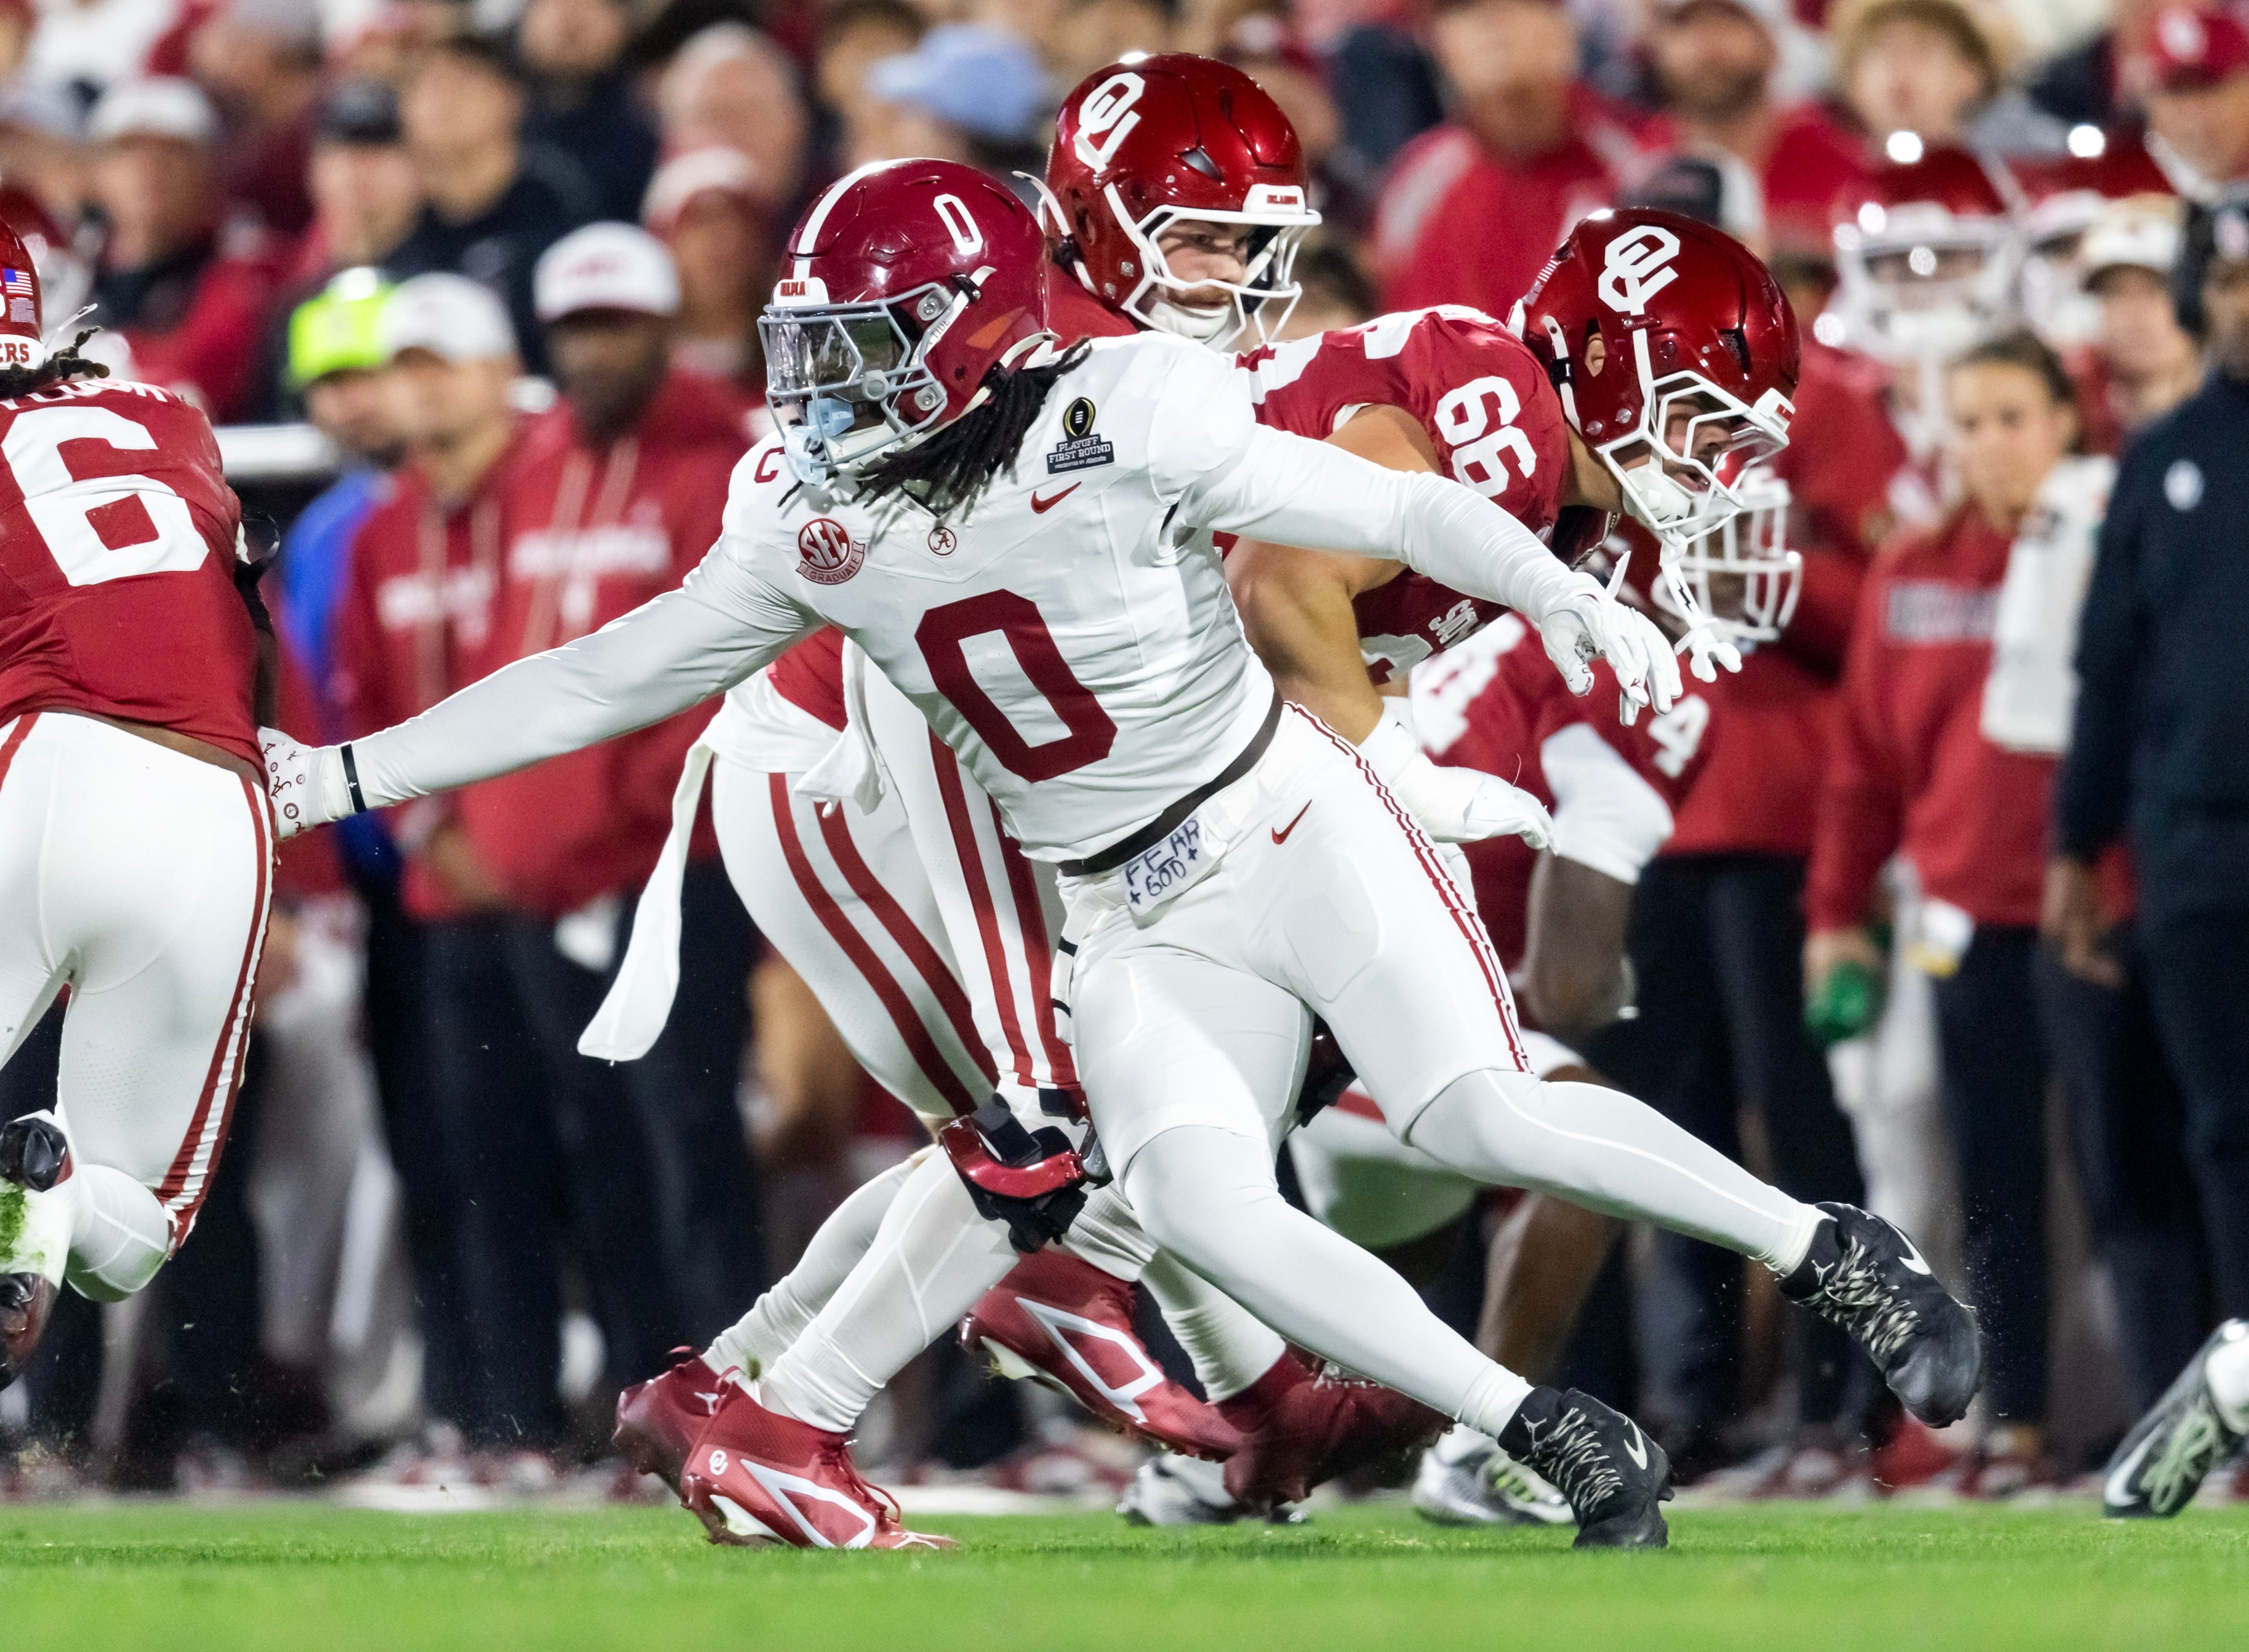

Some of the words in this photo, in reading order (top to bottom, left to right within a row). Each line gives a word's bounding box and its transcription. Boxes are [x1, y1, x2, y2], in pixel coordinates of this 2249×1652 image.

[933, 193, 984, 255] 0
[754, 445, 785, 484] C
[1049, 450, 1076, 463] FIRST
[1078, 444, 1111, 458] ROUND
[1058, 436, 1099, 452] PLAYOFF
[1434, 375, 1537, 499] 66
[1, 406, 210, 587] 6
[800, 520, 847, 568] SEC
[809, 555, 861, 583] GRADUATE
[914, 588, 1118, 784] 0
[1648, 695, 1710, 778] 4
[1125, 818, 1199, 886] FEAR
